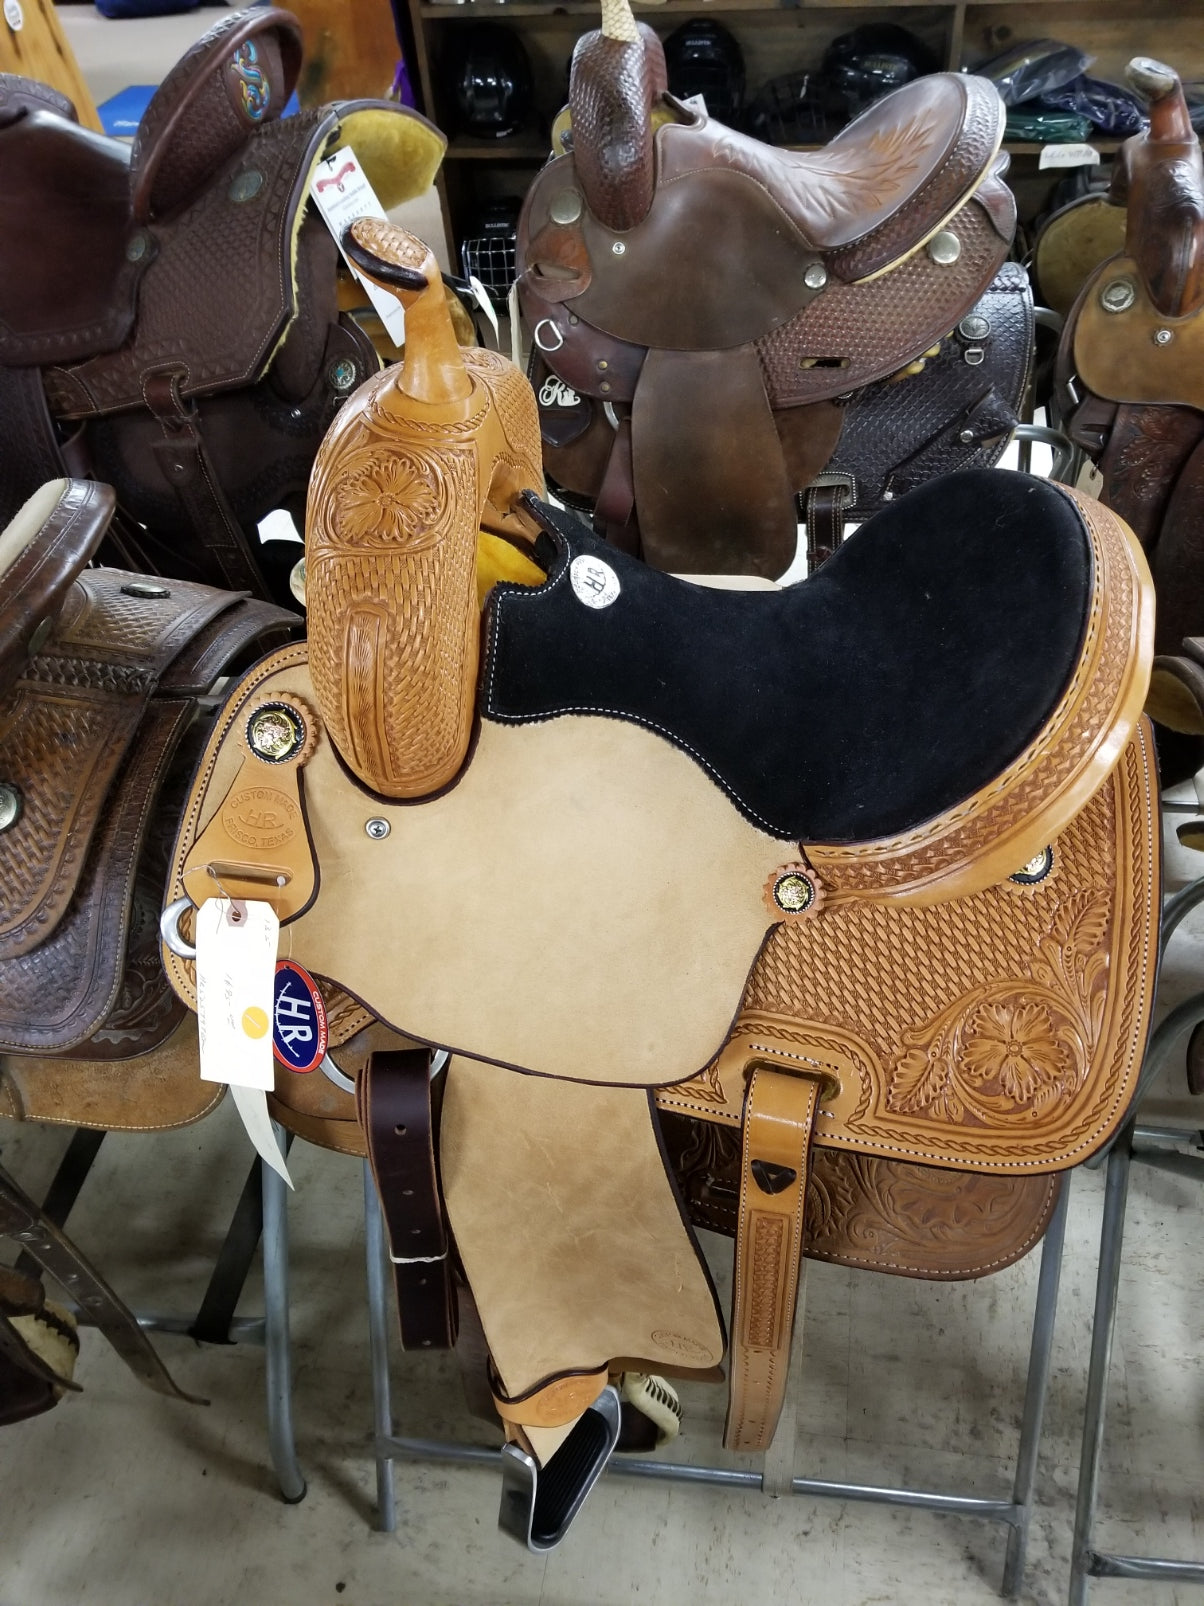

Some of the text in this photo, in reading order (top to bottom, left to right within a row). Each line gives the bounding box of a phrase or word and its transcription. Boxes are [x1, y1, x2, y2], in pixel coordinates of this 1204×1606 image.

[230, 790, 298, 820] CUSTOM MADE
[224, 816, 295, 847] FRISCO, TEXAS
[277, 995, 313, 1042] HR
[312, 990, 328, 1055] CUSTOM MADE
